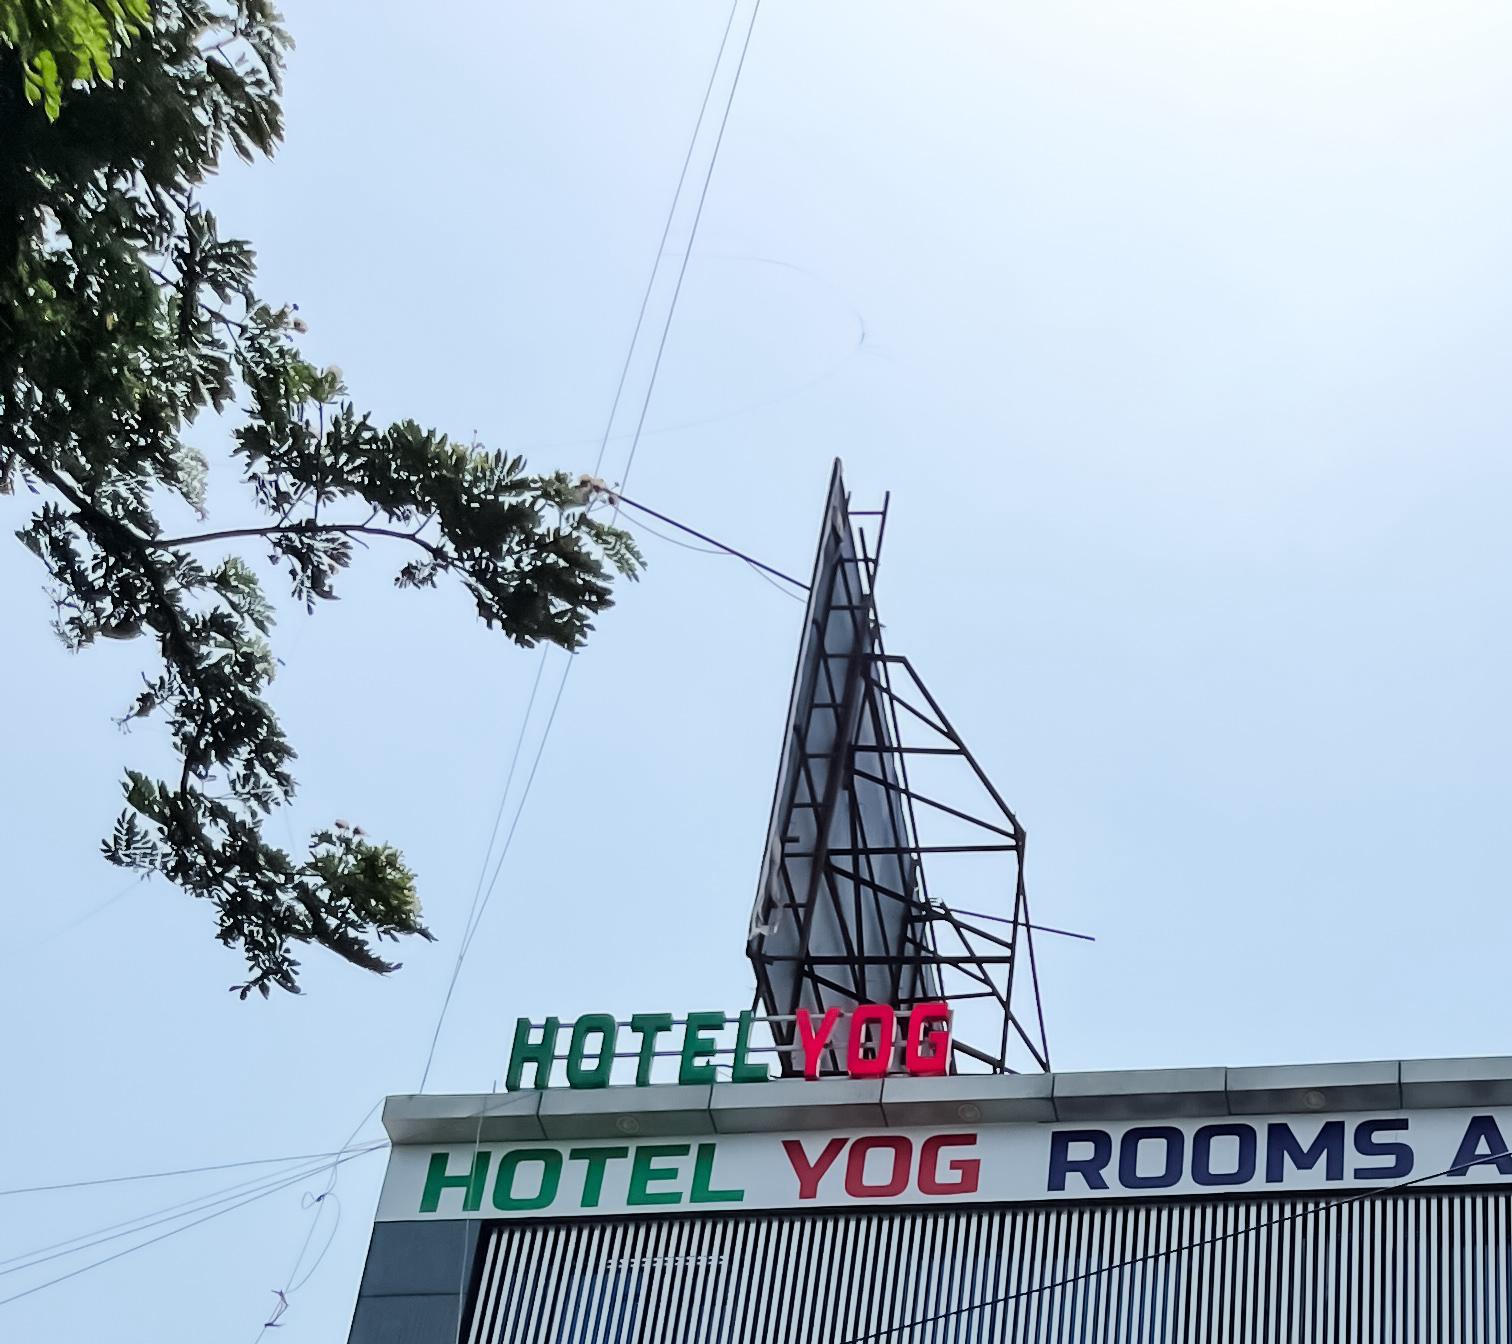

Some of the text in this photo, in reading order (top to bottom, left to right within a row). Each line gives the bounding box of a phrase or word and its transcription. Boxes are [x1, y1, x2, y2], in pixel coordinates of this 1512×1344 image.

[506, 1002, 954, 1092] HOTEL YOG
[419, 1143, 745, 1213] HOTEL
[782, 1133, 981, 1199] YOG
[1047, 1117, 1414, 1192] ROOMS
